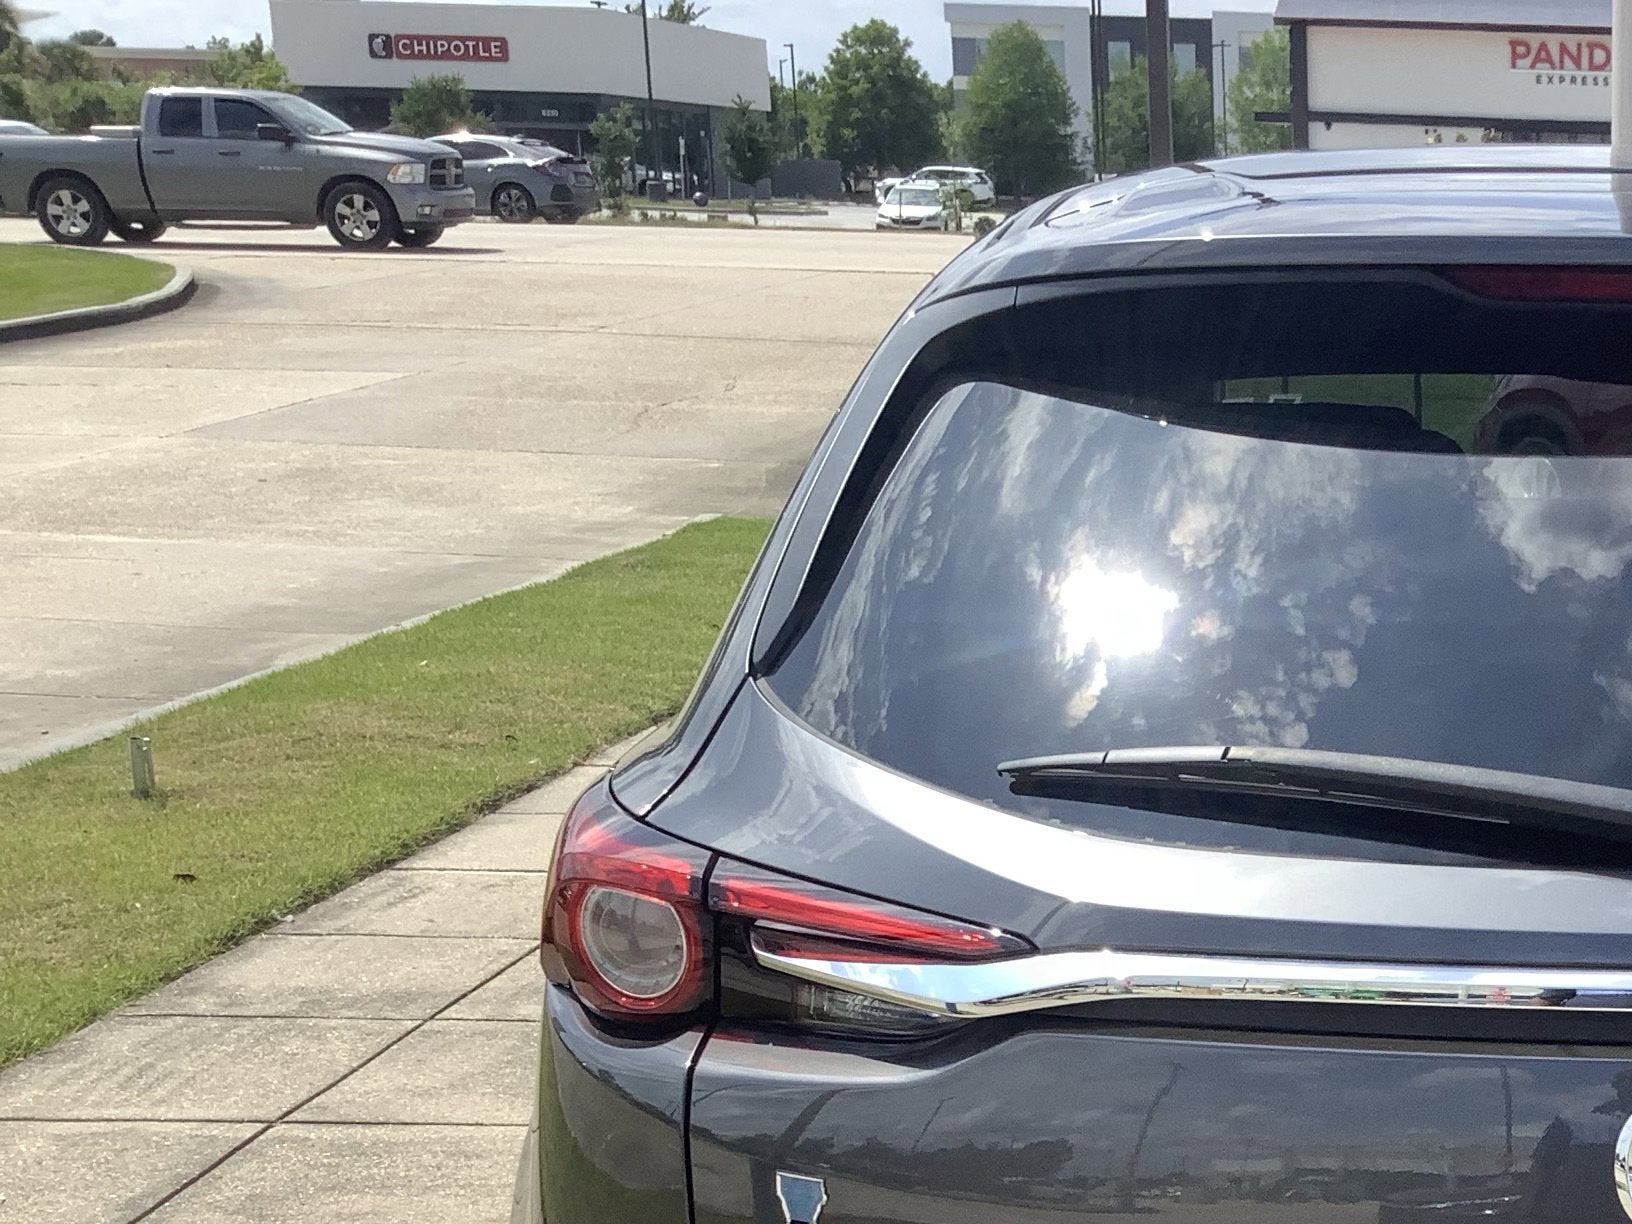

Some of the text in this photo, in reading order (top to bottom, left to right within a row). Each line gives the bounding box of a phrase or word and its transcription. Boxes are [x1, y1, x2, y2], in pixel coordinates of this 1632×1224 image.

[398, 39, 503, 57] CHIPOTLE
[1508, 39, 1612, 71] PAND
[1535, 74, 1610, 86] EXPRESS
